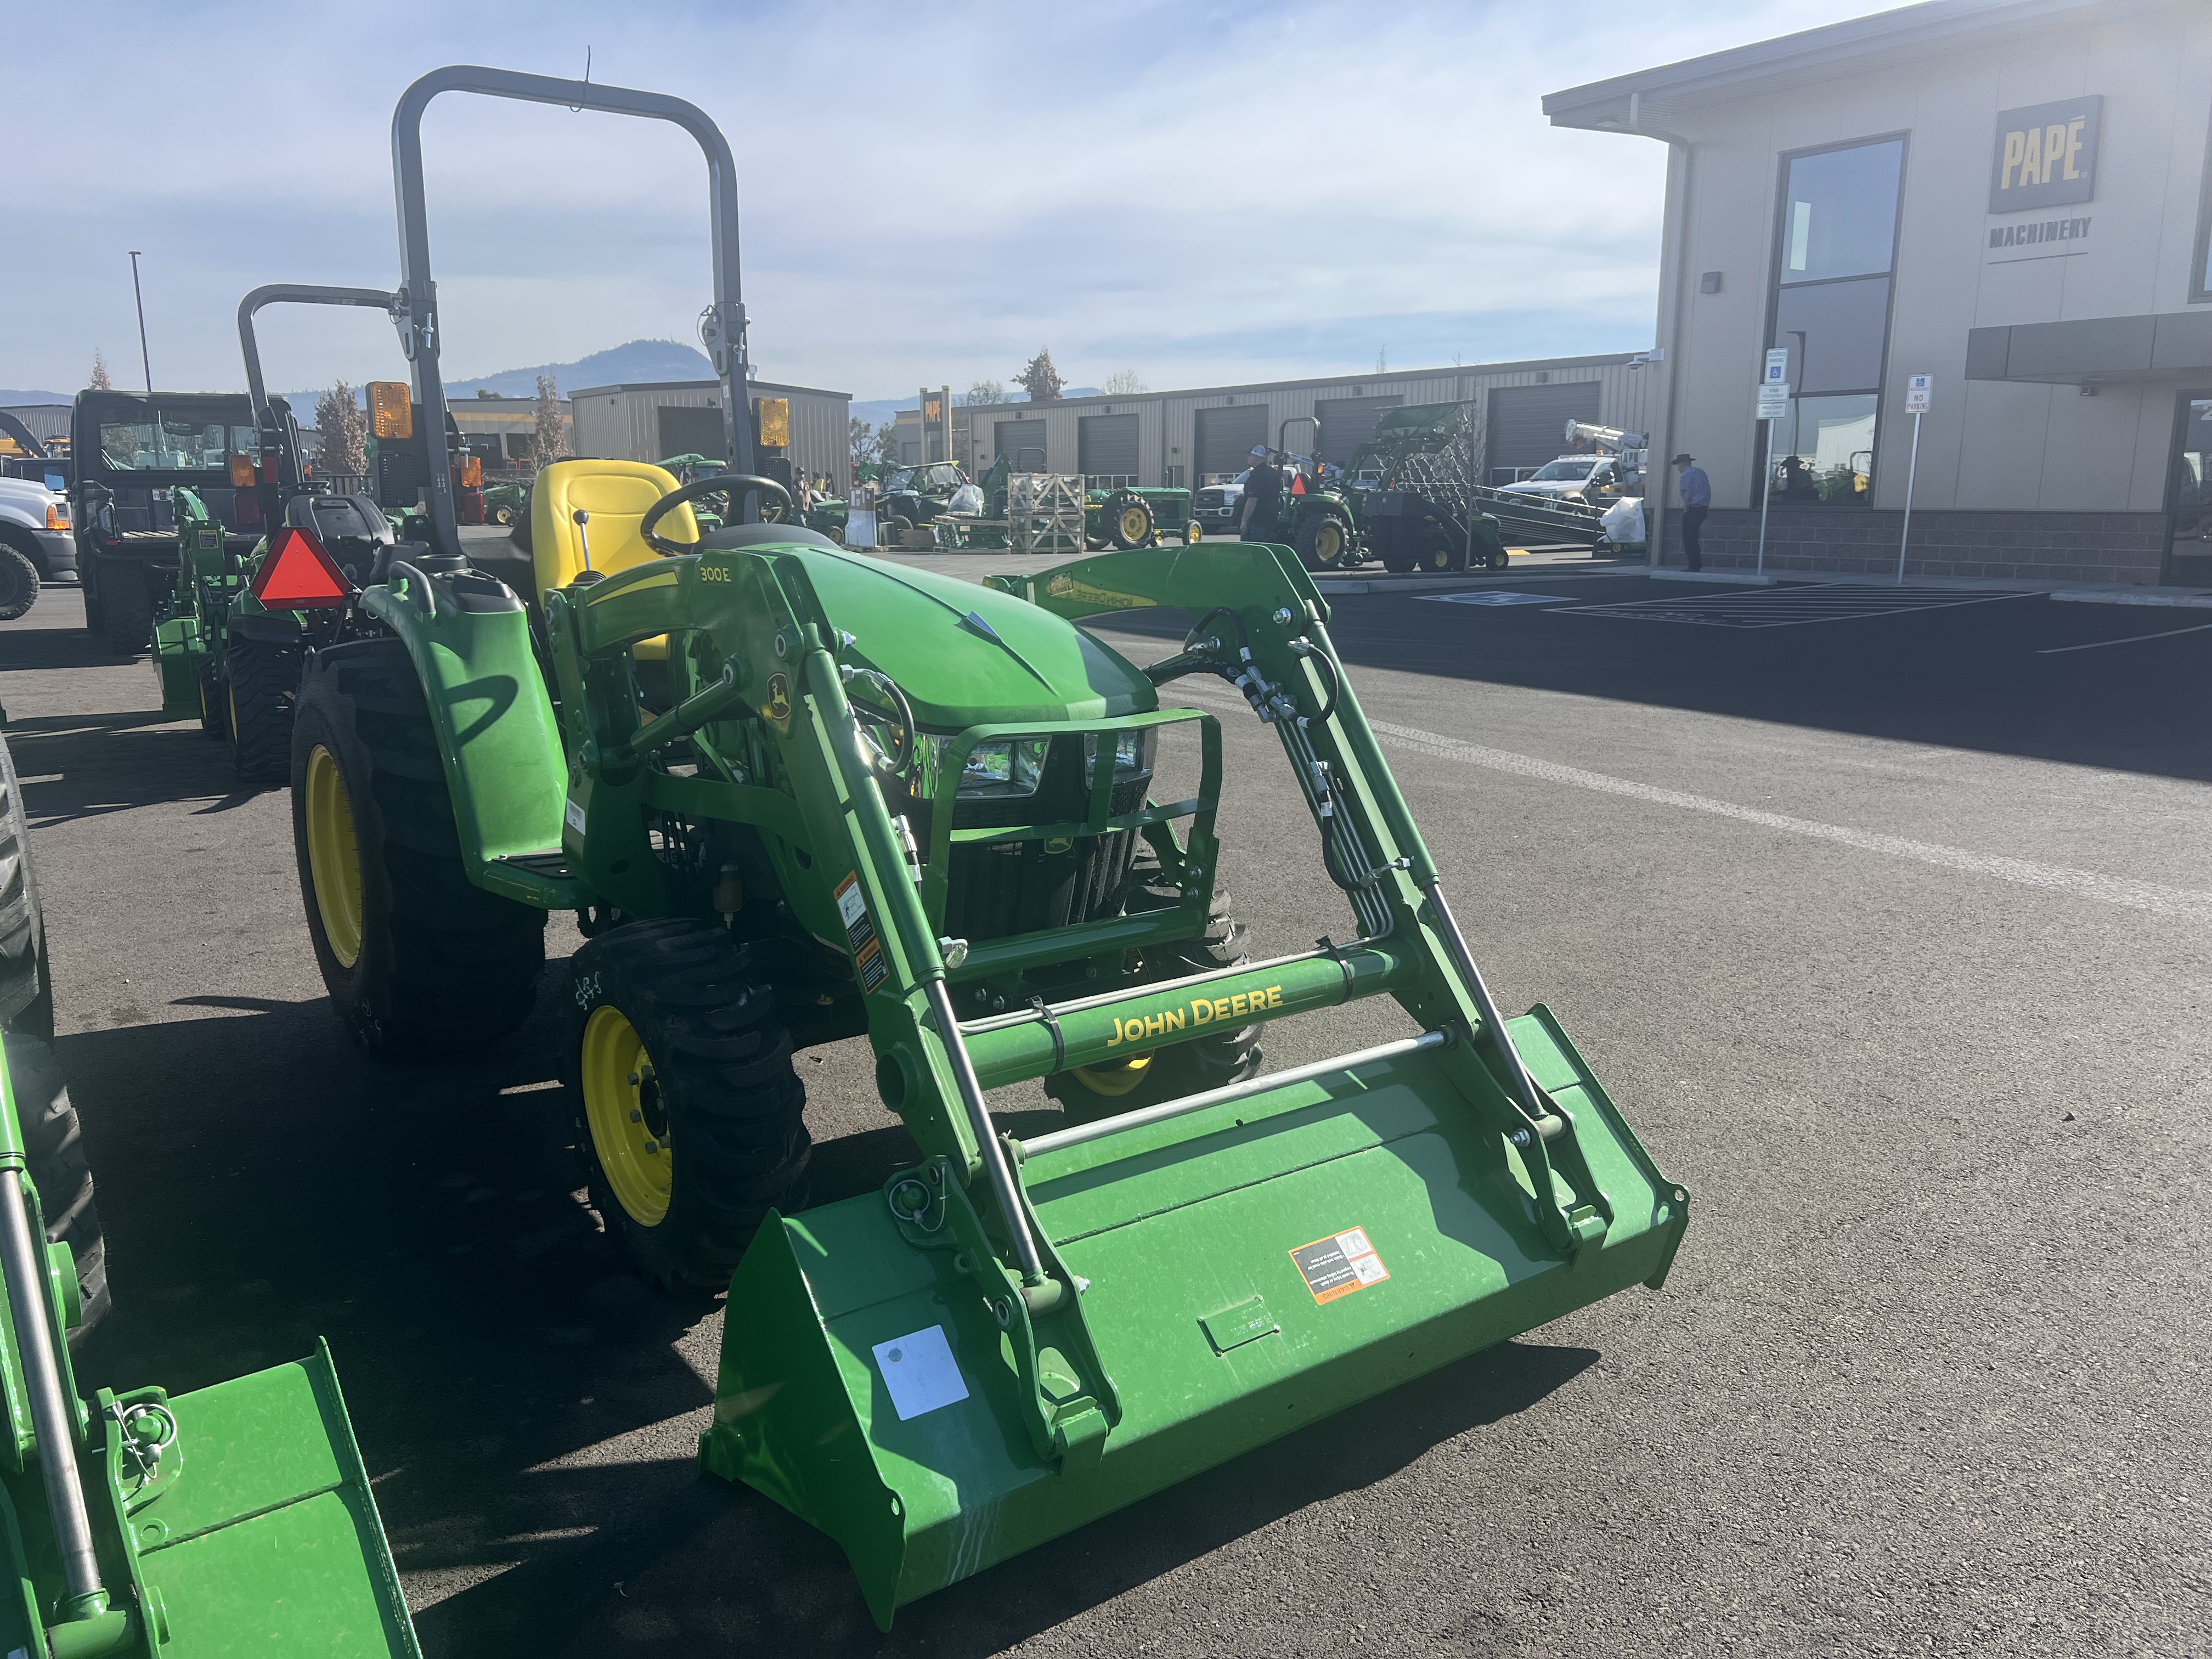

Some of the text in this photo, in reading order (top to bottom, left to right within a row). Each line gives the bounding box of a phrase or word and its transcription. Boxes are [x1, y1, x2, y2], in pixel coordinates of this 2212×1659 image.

[1989, 217, 2092, 248] MACHINERY
[700, 567, 731, 582] 300E
[1107, 985, 1283, 1047] JOHN DEERE
[1323, 1284, 1351, 1300] WARNING
